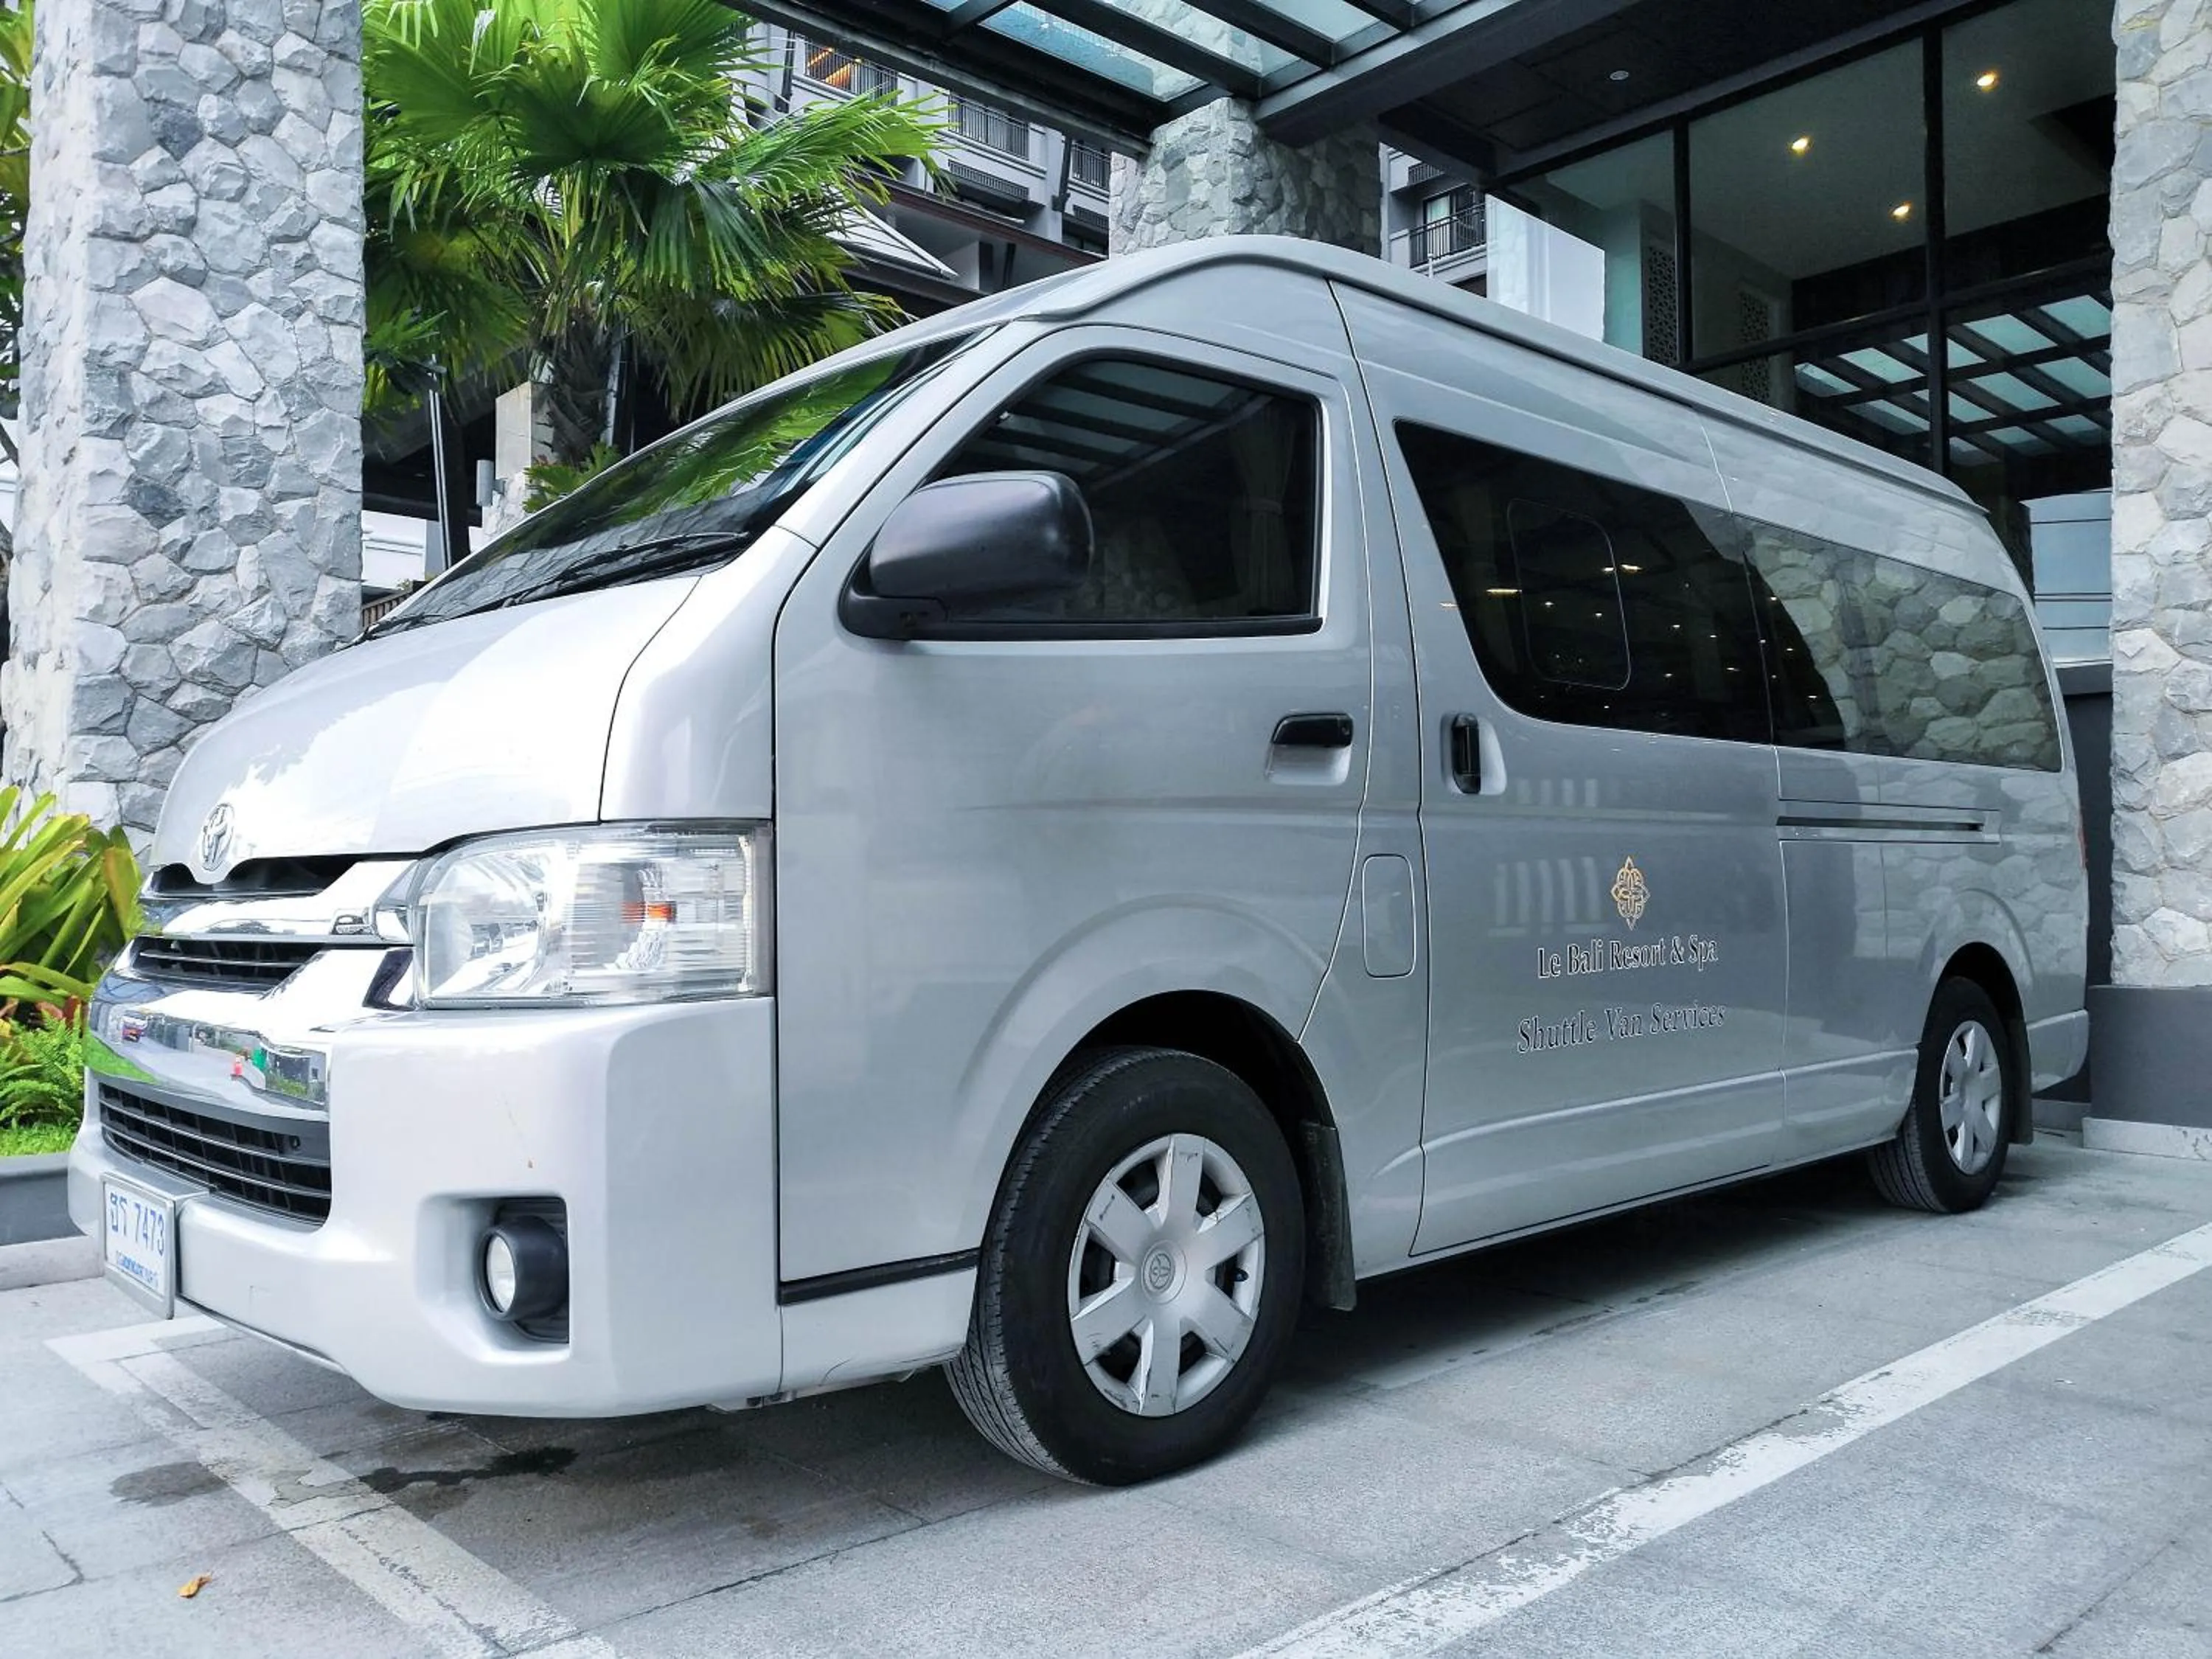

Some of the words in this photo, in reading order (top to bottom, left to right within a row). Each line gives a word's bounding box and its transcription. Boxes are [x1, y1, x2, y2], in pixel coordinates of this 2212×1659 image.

[1537, 947, 1561, 978] Le
[1567, 939, 1604, 975] Bali
[1610, 937, 1666, 970] Resort
[1670, 935, 1685, 964] &
[1688, 934, 1719, 972] Spa
[1517, 1010, 1597, 1054] Shuttle
[1604, 1006, 1644, 1040] Van
[1650, 1001, 1727, 1034] Services
[133, 1202, 165, 1257] 7473
